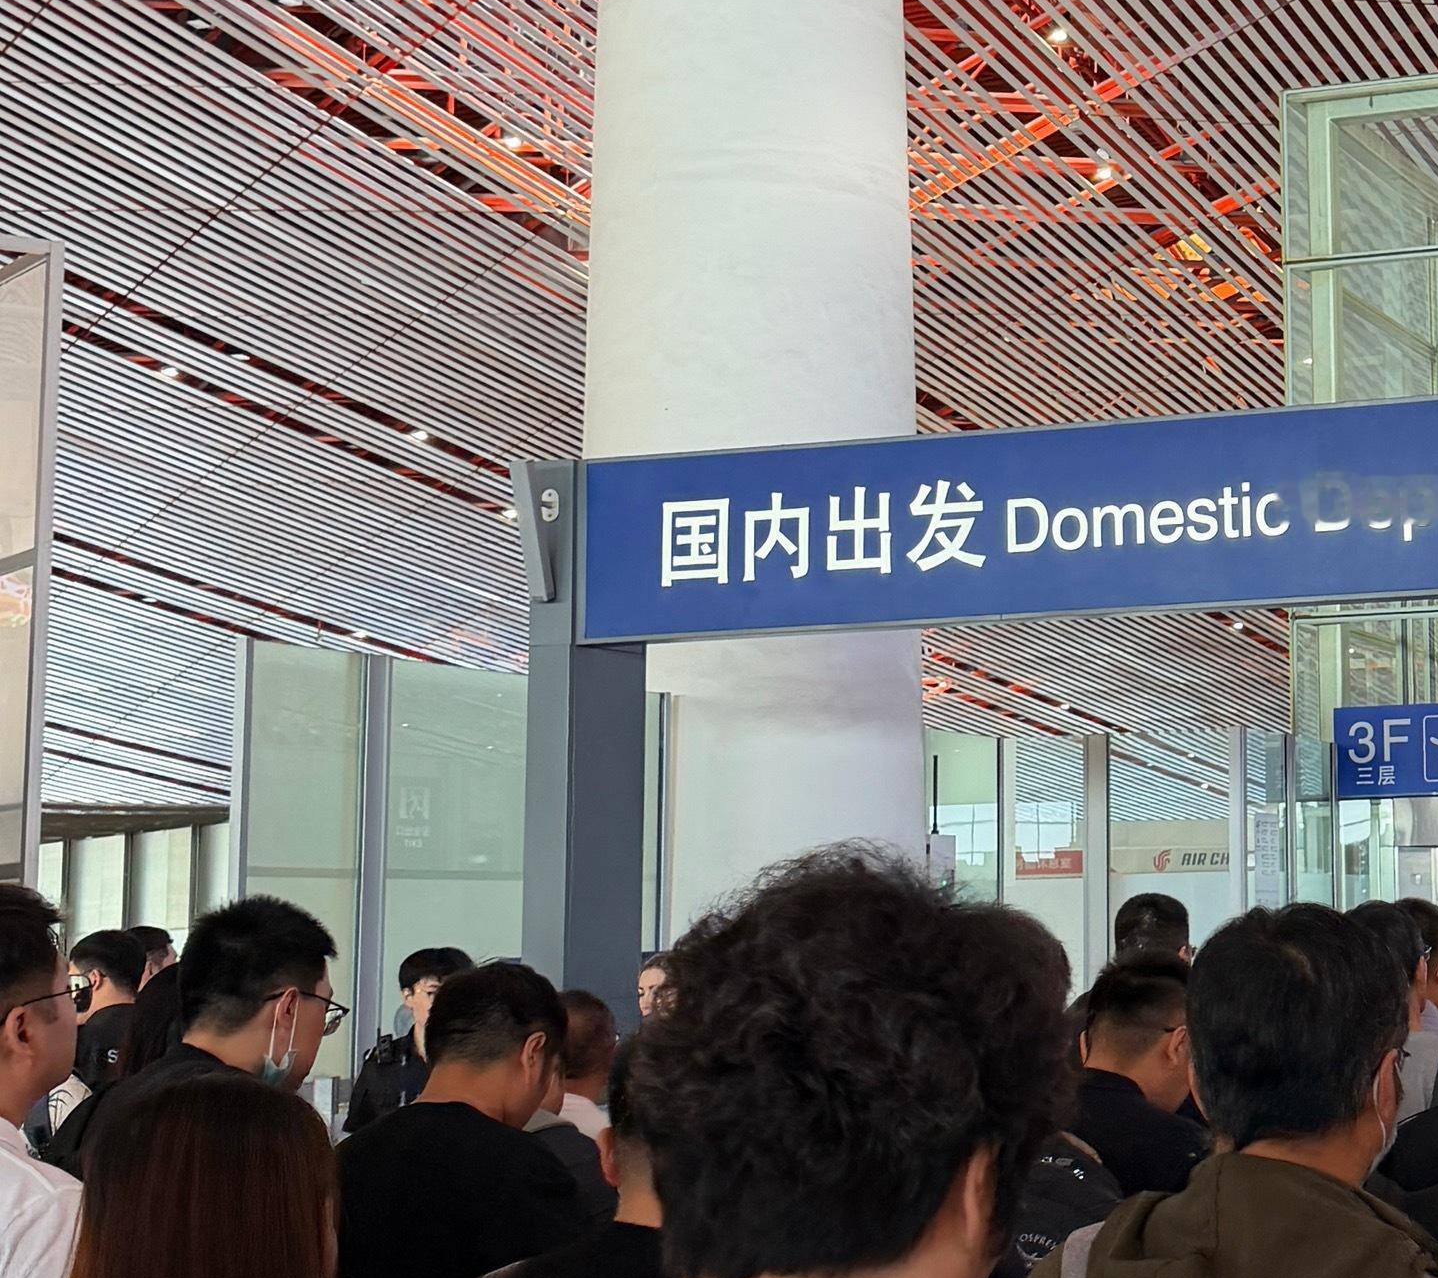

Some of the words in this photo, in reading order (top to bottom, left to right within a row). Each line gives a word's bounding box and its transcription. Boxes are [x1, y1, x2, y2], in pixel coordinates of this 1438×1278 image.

[660, 479, 988, 588] 国内出发
[1006, 481, 1291, 554] Domestic
[1348, 717, 1412, 765] 3F
[1356, 765, 1396, 786] 三层
[1181, 852, 1207, 866] AIR
